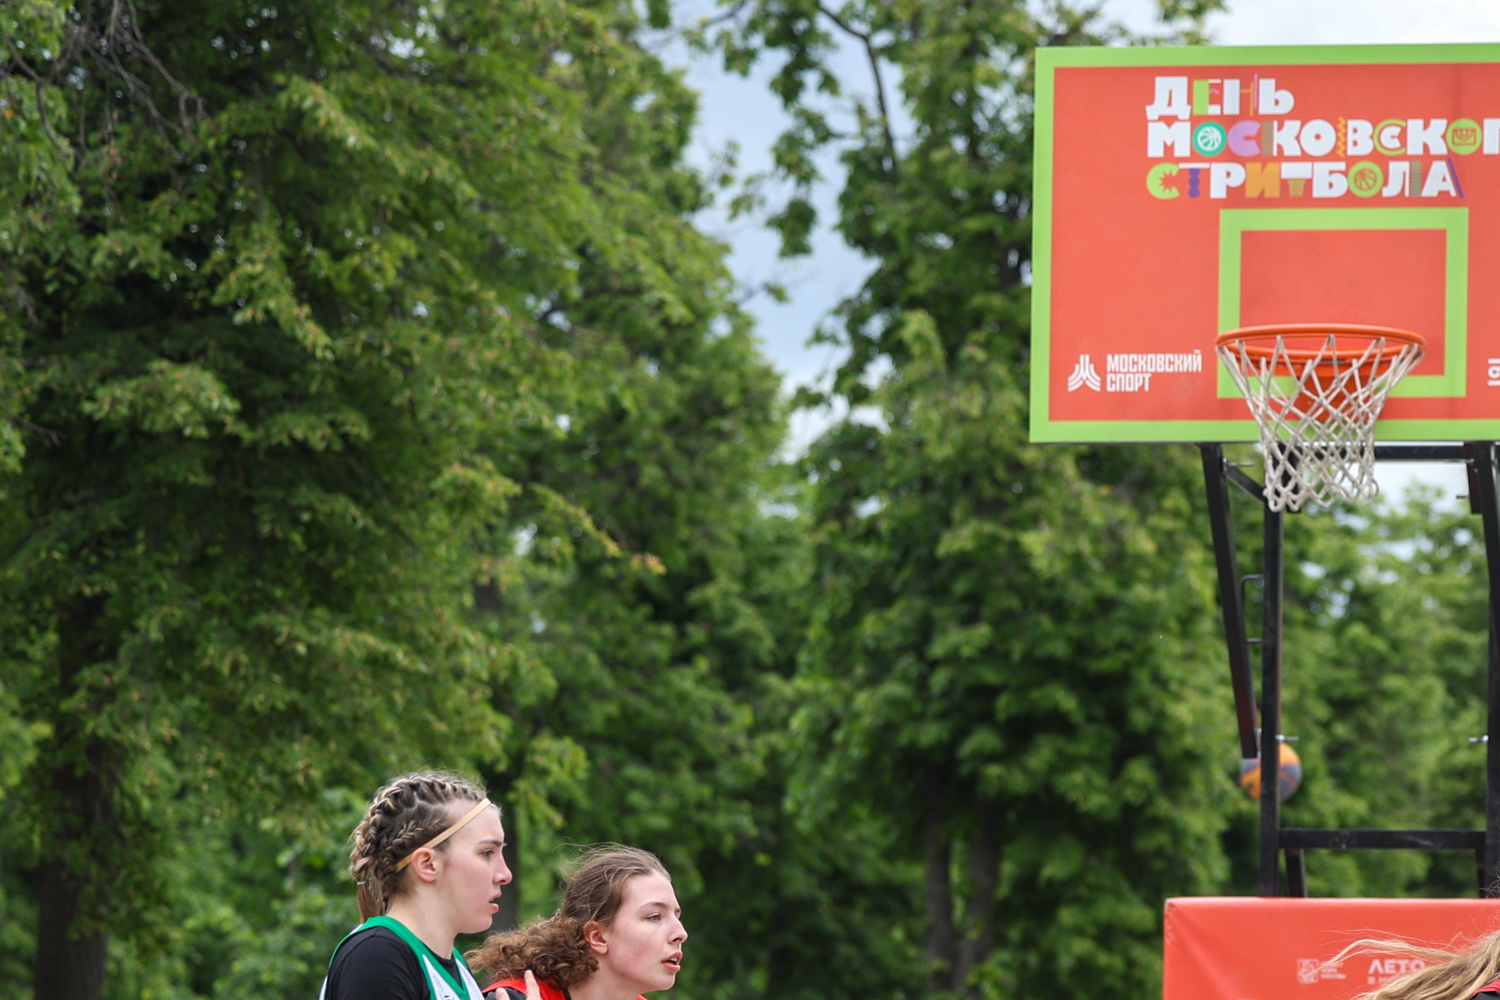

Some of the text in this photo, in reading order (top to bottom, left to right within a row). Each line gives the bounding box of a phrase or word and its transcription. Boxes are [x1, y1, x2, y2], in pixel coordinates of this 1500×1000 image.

[1146, 73, 1295, 121] ДЕНЬ
[1146, 157, 1465, 200] СТРИТБОЛА
[1106, 349, 1202, 373] МОСКОВСКИЙ
[1106, 373, 1152, 392] СПОРТ
